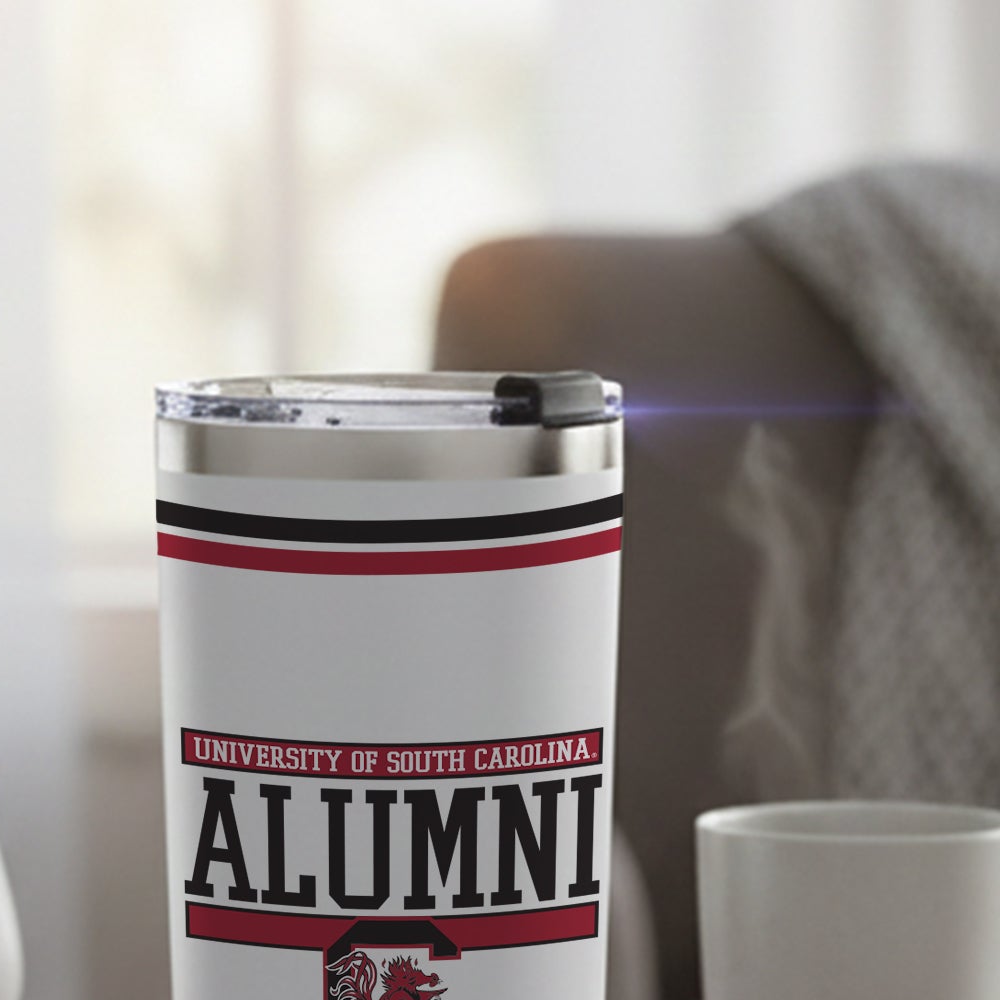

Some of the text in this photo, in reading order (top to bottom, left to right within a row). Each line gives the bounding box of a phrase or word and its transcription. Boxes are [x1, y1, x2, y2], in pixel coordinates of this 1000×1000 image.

[193, 736, 591, 774] UNIVERSITY OF SOUTH CAROLINA
[184, 773, 603, 910] ALUMNI
